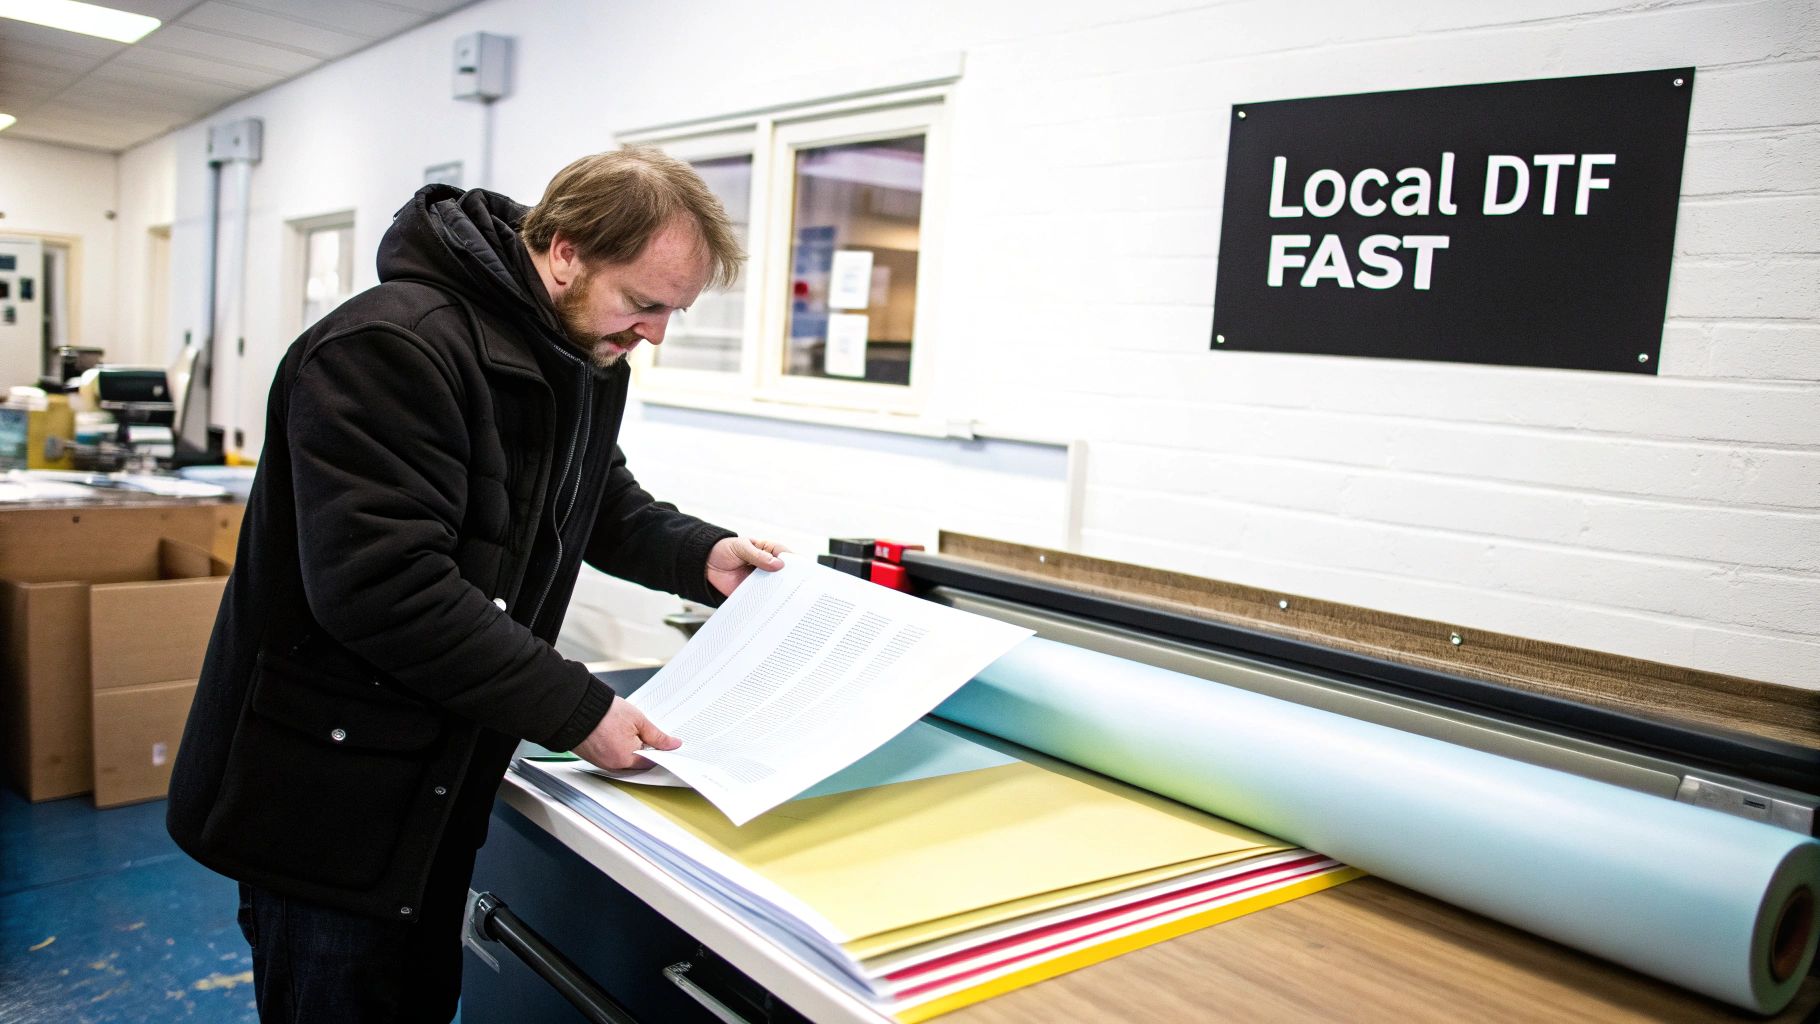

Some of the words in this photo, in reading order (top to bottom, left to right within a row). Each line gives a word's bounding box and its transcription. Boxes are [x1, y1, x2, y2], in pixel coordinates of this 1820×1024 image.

[1268, 151, 1458, 219] Local
[1482, 152, 1617, 217] DTF
[1267, 233, 1450, 290] FAST
